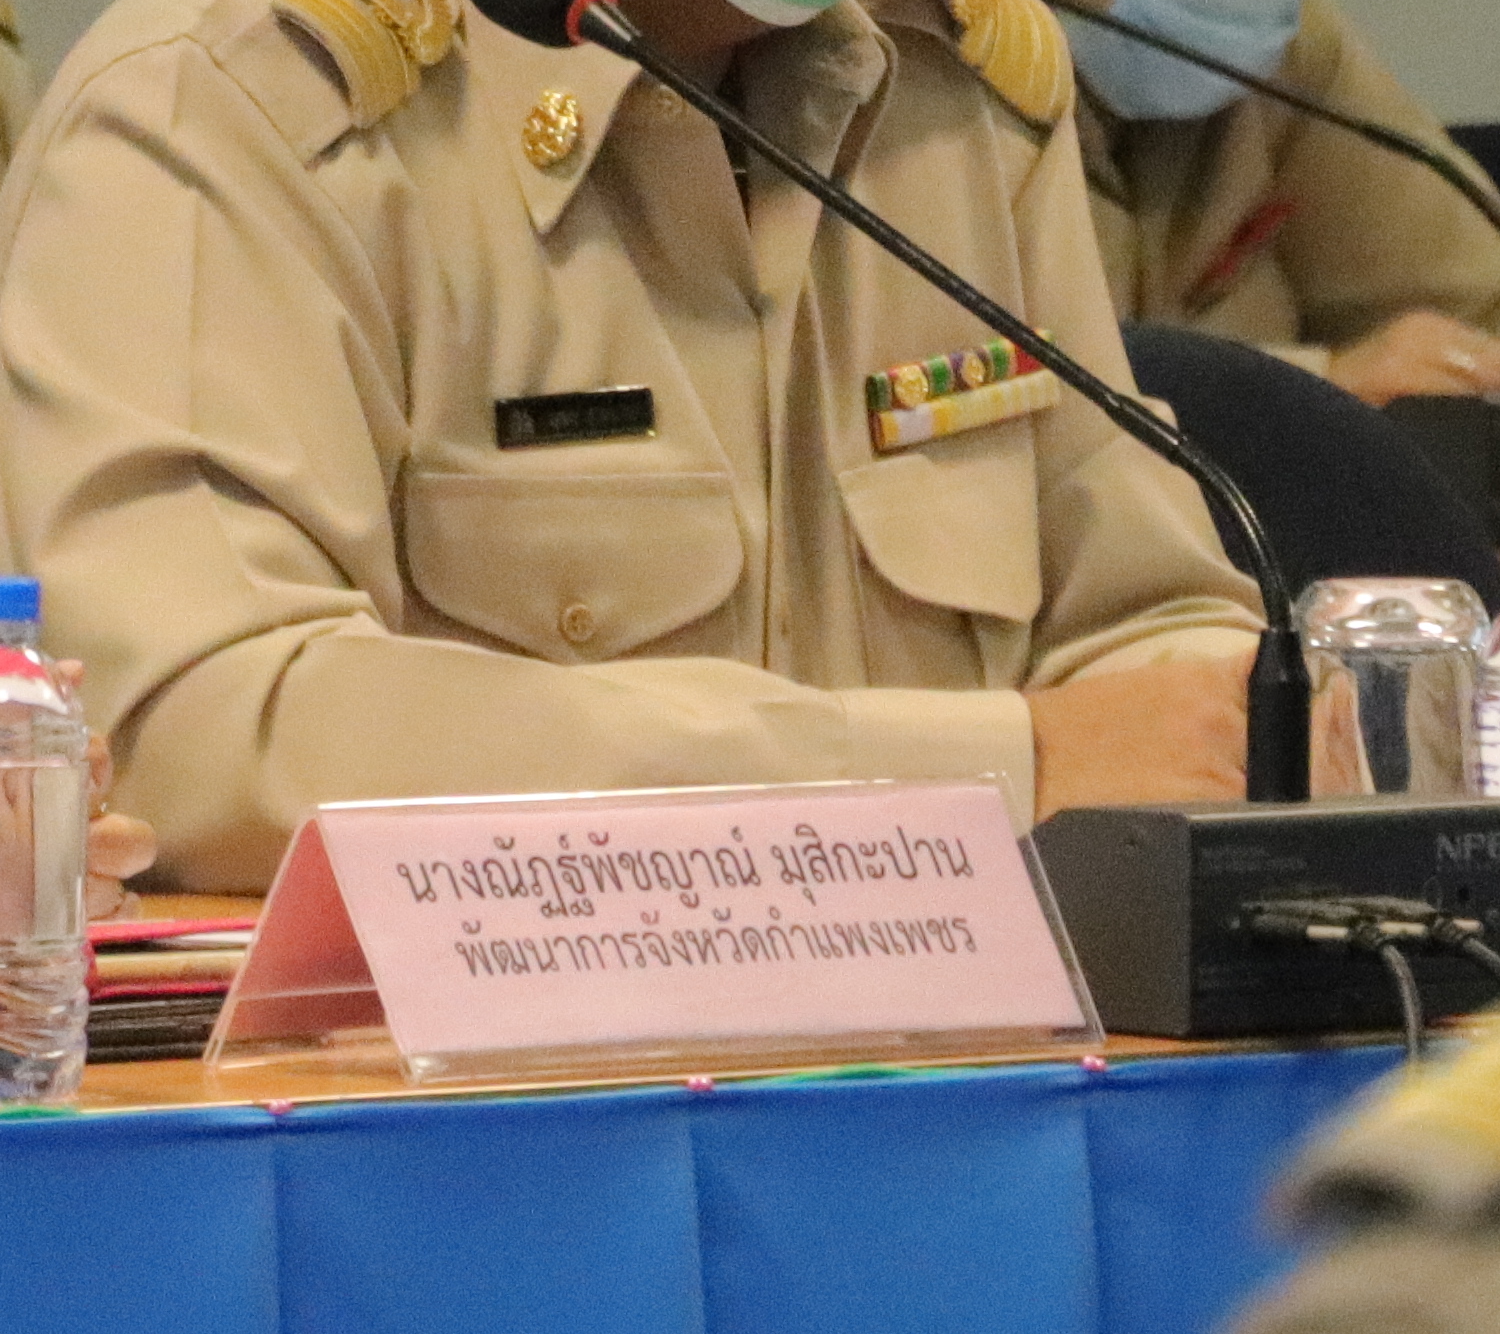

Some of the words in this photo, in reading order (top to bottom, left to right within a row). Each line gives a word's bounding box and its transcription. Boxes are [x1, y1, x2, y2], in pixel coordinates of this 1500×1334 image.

[770, 823, 975, 907] มุสิกะปาน
[455, 904, 977, 978] พัฒนาการจังหวัดกำแพงเพชร
